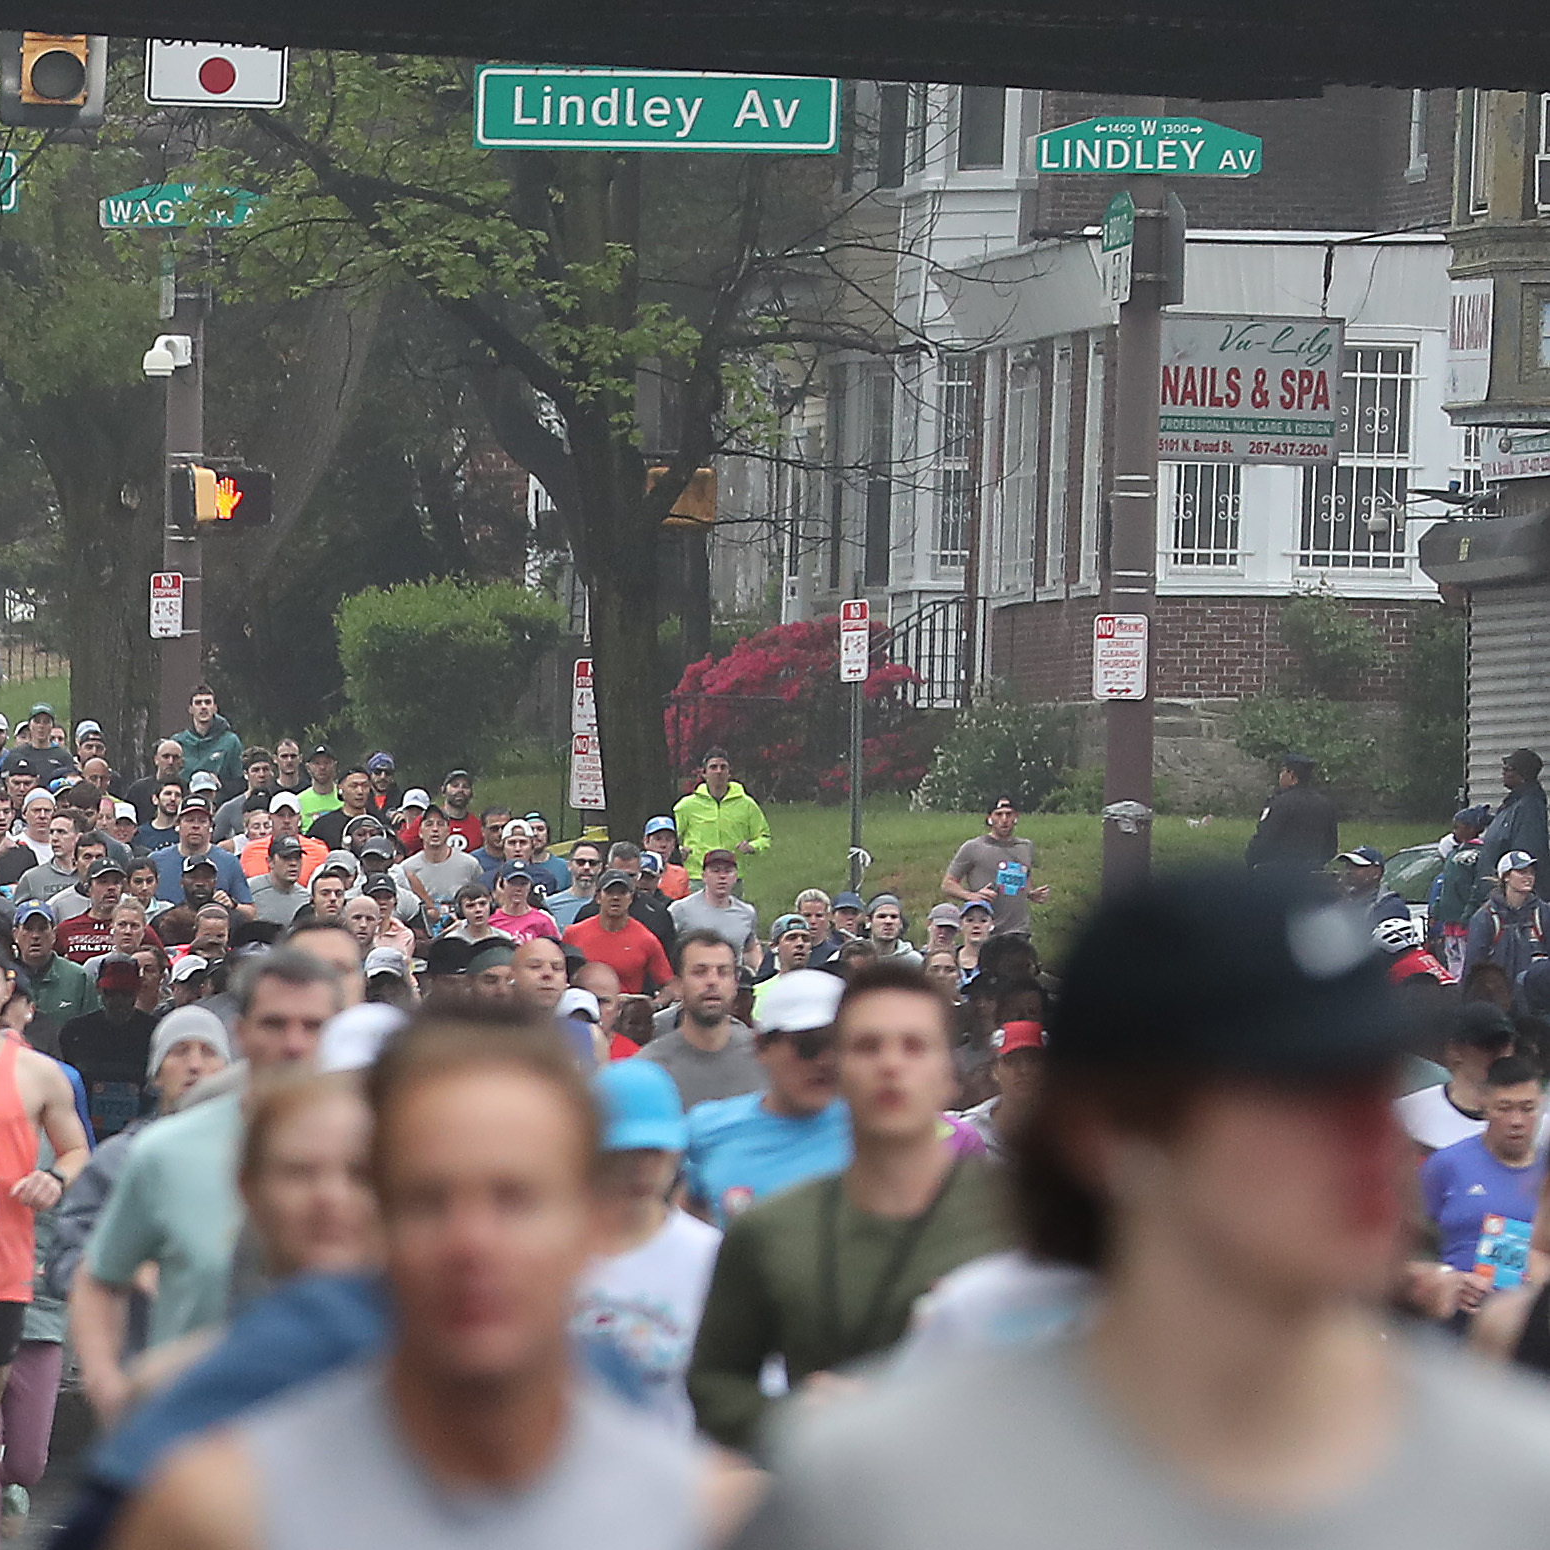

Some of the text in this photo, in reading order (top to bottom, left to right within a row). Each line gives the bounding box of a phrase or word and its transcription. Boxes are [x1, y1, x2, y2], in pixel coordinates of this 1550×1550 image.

[513, 85, 800, 137] Lindley Av
[1108, 120, 1190, 136] 1400 W 1300
[1040, 139, 1256, 170] LINDLEY AV
[1219, 323, 1333, 367] Vu-Lily
[1161, 365, 1331, 411] NAILS & SPA
[1160, 419, 1331, 434] PROFESSIONAL NAIL CARE & DESIGN
[1158, 438, 1179, 451] 5101
[1194, 440, 1221, 452] Broad
[1249, 441, 1329, 457] 267-437-2204
[1098, 619, 1115, 635] NO
[1101, 649, 1140, 658] CLEANING
